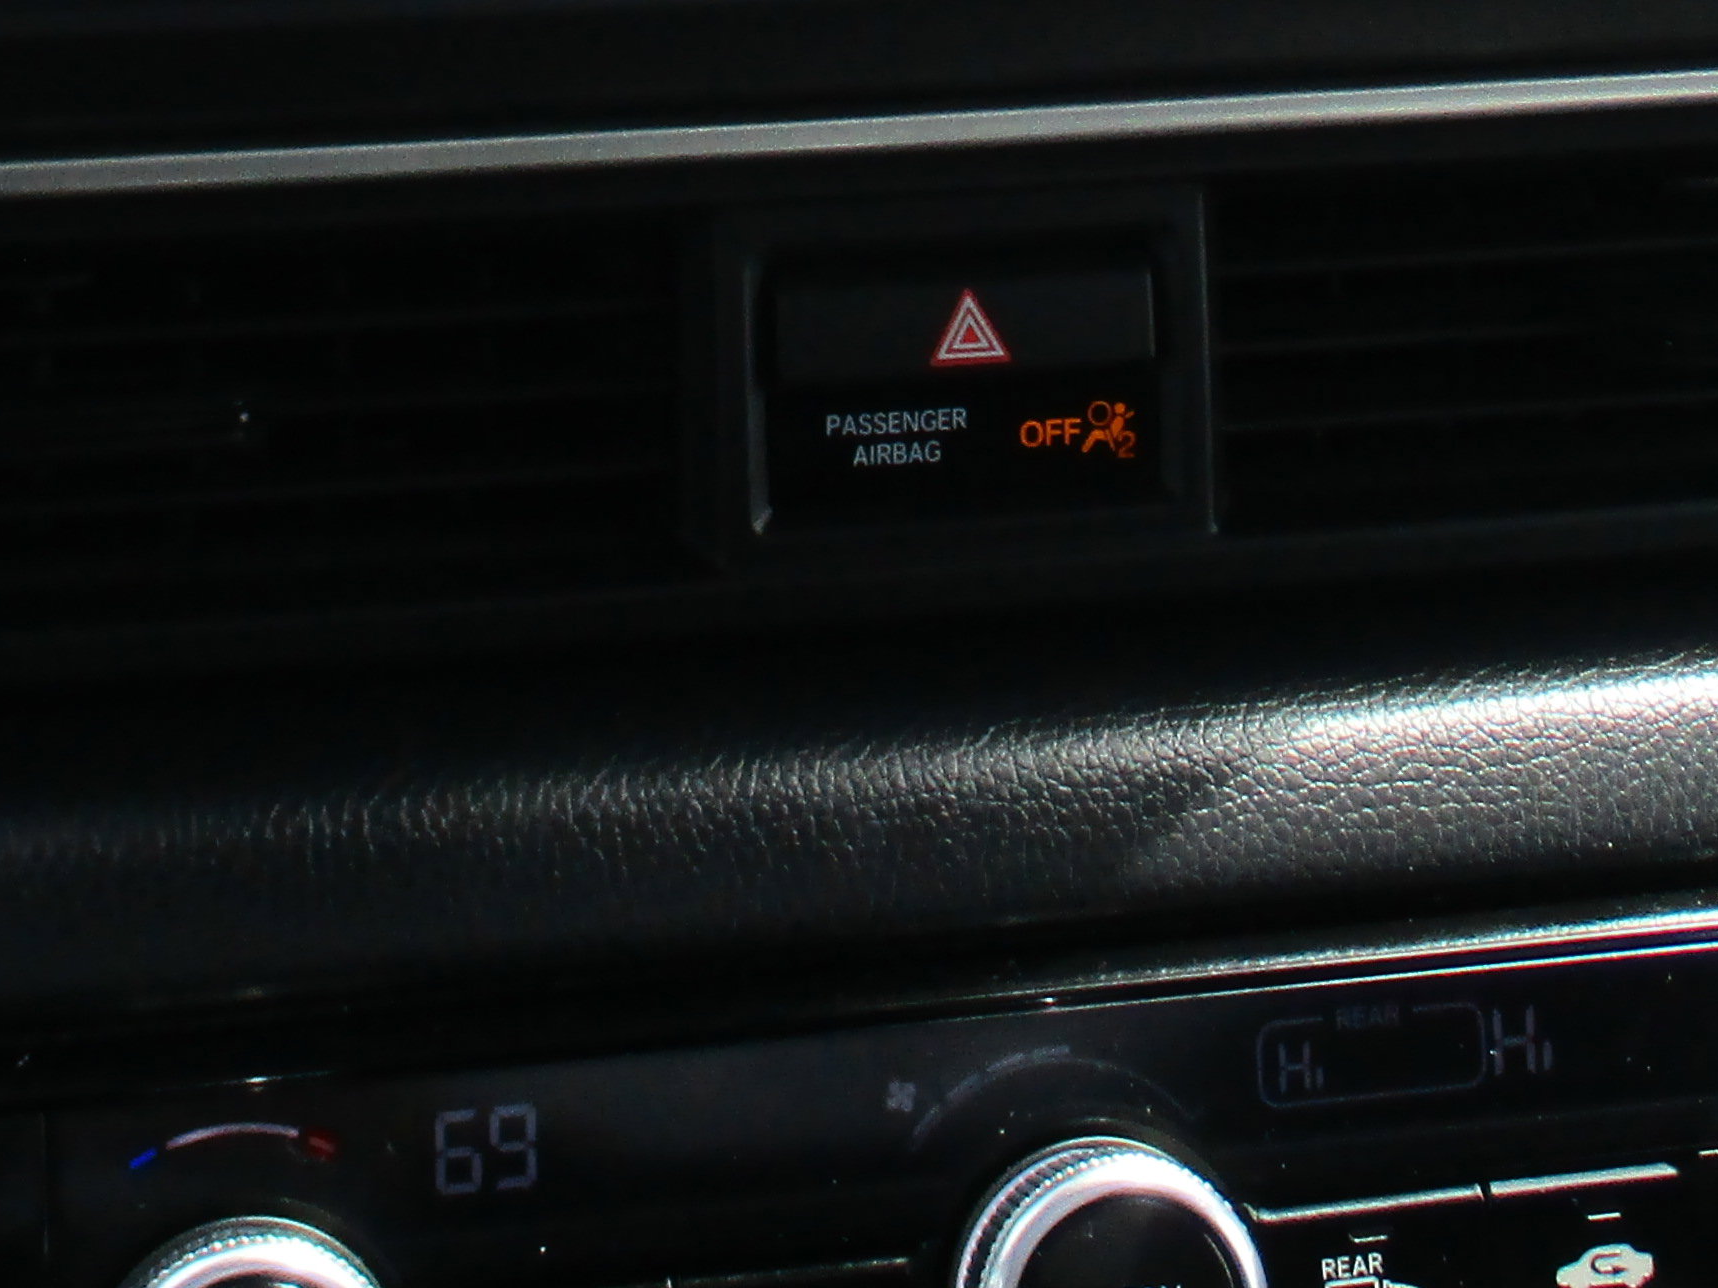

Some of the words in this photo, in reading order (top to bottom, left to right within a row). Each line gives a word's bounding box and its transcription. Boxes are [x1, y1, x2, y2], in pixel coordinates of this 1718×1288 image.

[826, 407, 967, 436] PASSENGER
[1020, 417, 1082, 448] OFF
[853, 439, 941, 466] AIRBAG
[434, 1100, 538, 1194] 69
[1321, 1251, 1386, 1280] REAR
